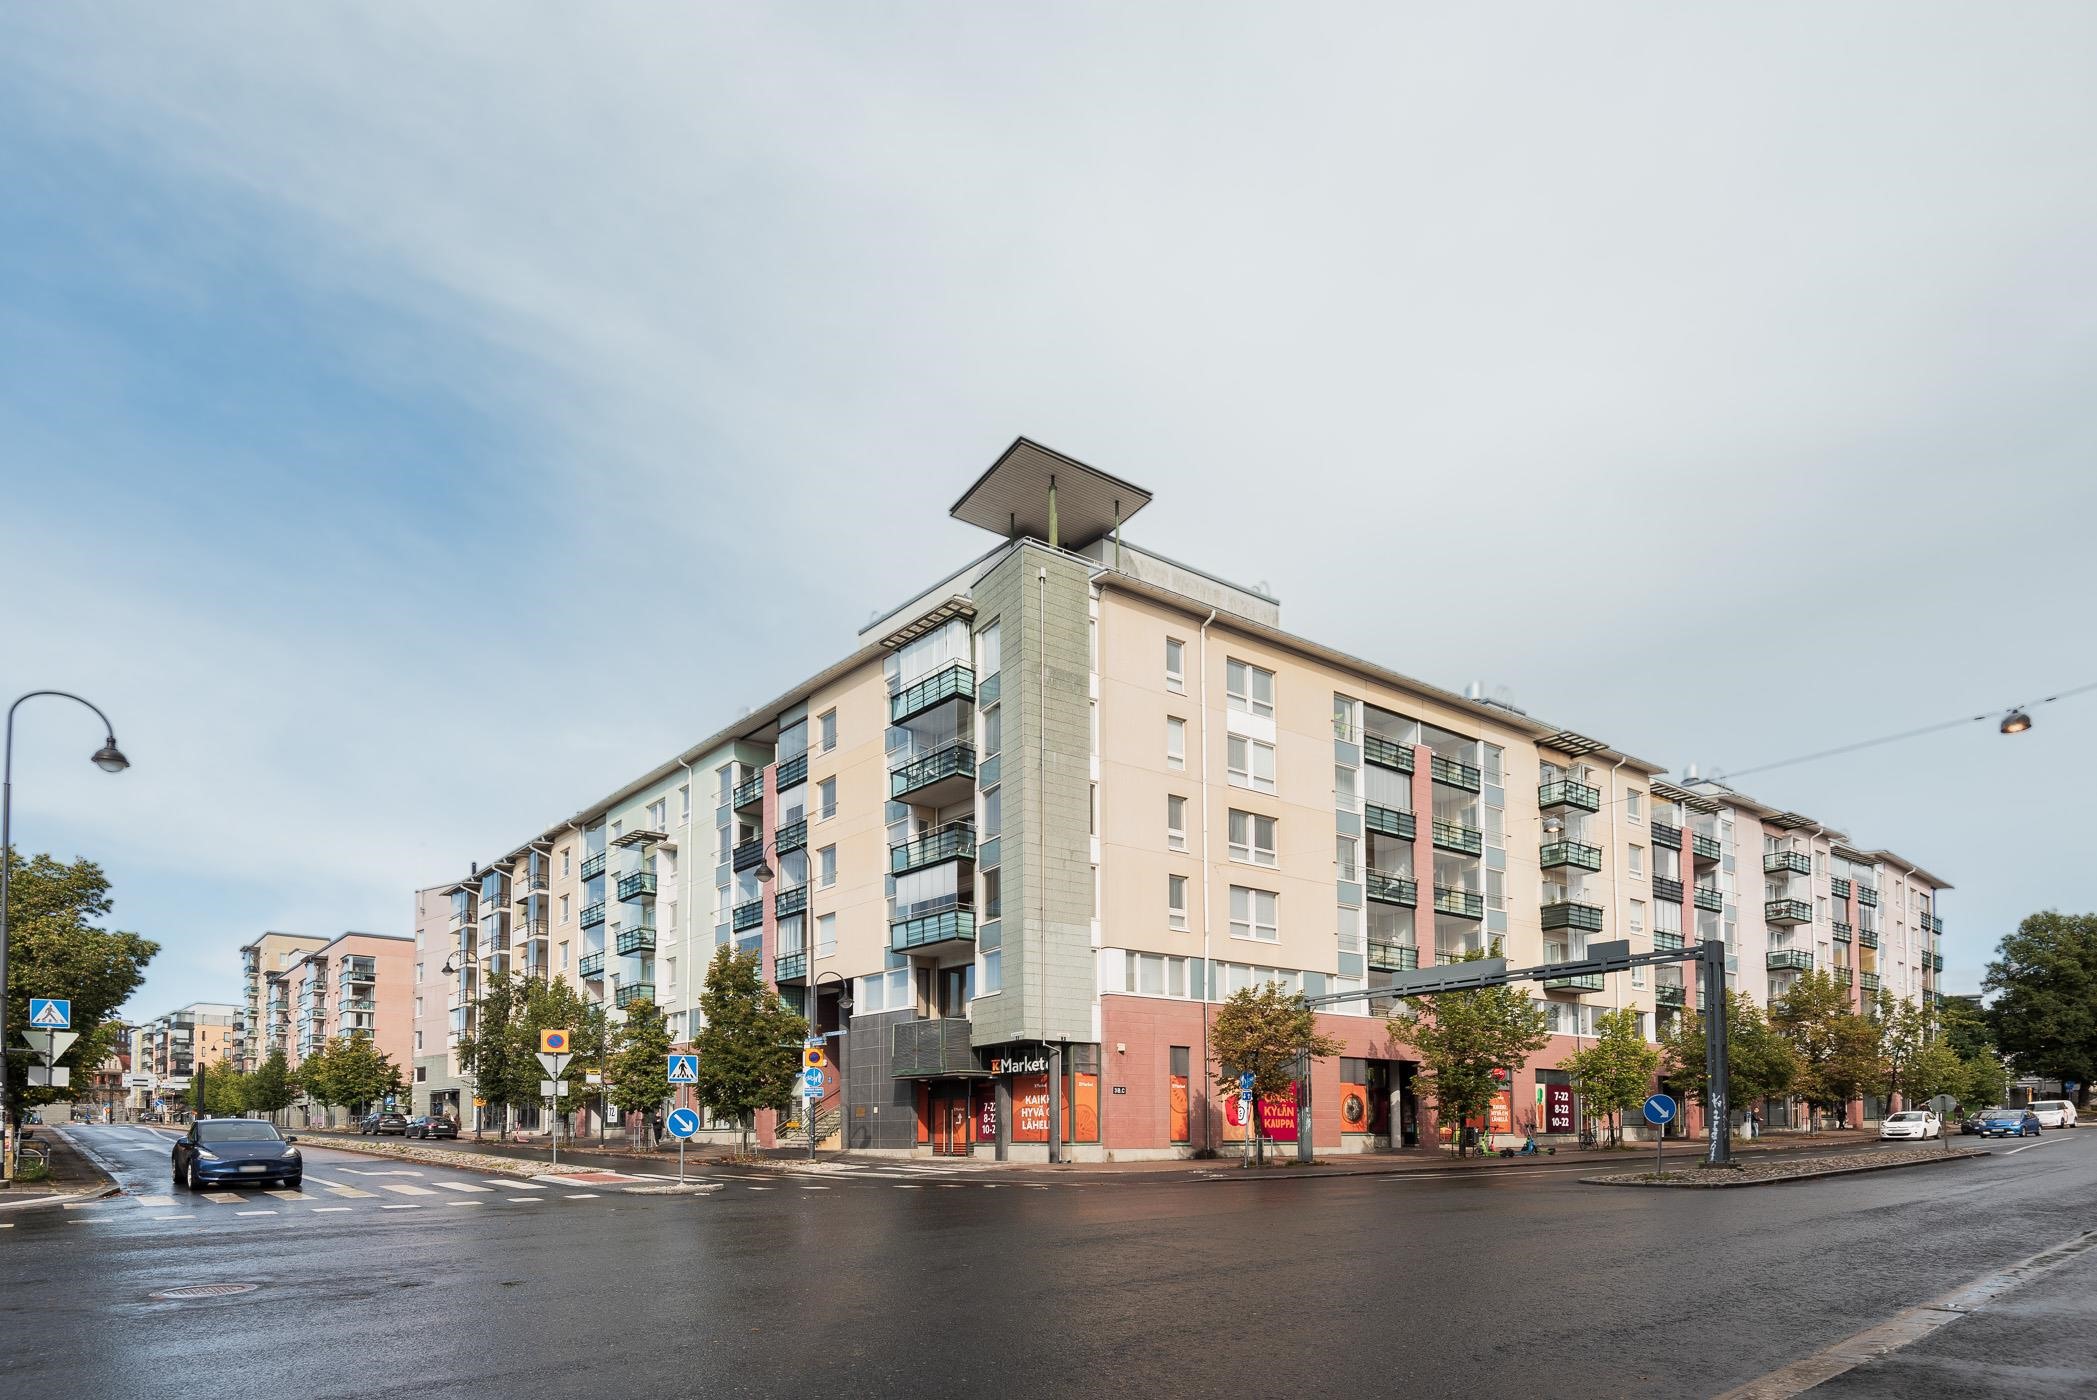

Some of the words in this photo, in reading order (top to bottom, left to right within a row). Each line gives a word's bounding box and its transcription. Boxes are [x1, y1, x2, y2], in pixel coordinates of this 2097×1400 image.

[1001, 1056, 1045, 1073] Market
[1554, 1092, 1569, 1100] 7-22
[1021, 1105, 1044, 1117] HYVÄ
[1264, 1104, 1294, 1116] KYLÄN
[1554, 1105, 1569, 1113] 8-22
[1022, 1118, 1050, 1130] LÄHEL
[1264, 1119, 1295, 1128] KAUPPA
[1552, 1118, 1569, 1126] 10-22
